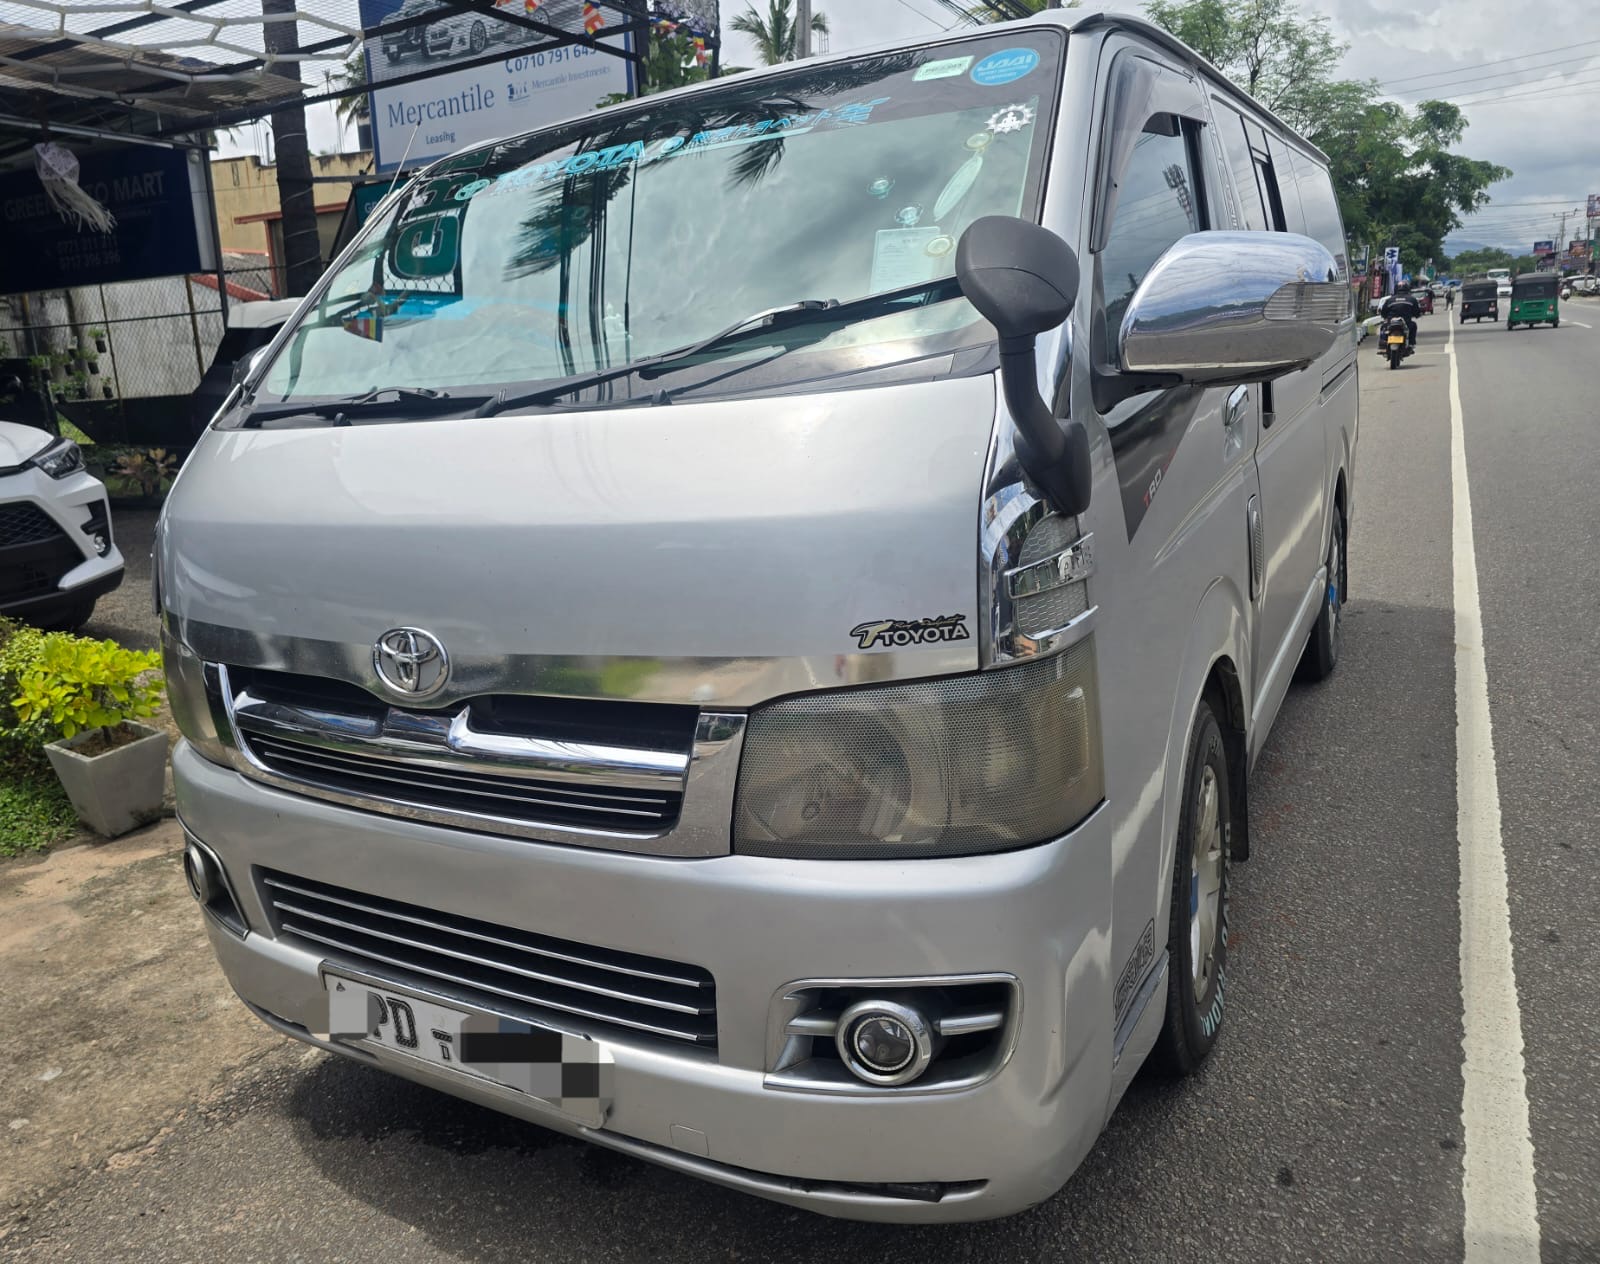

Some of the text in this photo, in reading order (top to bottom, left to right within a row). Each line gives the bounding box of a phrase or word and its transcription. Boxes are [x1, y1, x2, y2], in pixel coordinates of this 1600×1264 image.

[514, 52, 545, 72] 0710
[549, 47, 570, 67] 791
[568, 65, 611, 82] Investments
[388, 83, 496, 129] Mercantile
[425, 131, 456, 146] Leasing
[497, 139, 646, 191] TOYOTA
[113, 171, 165, 202] MART
[880, 624, 968, 645] TOYOTA
